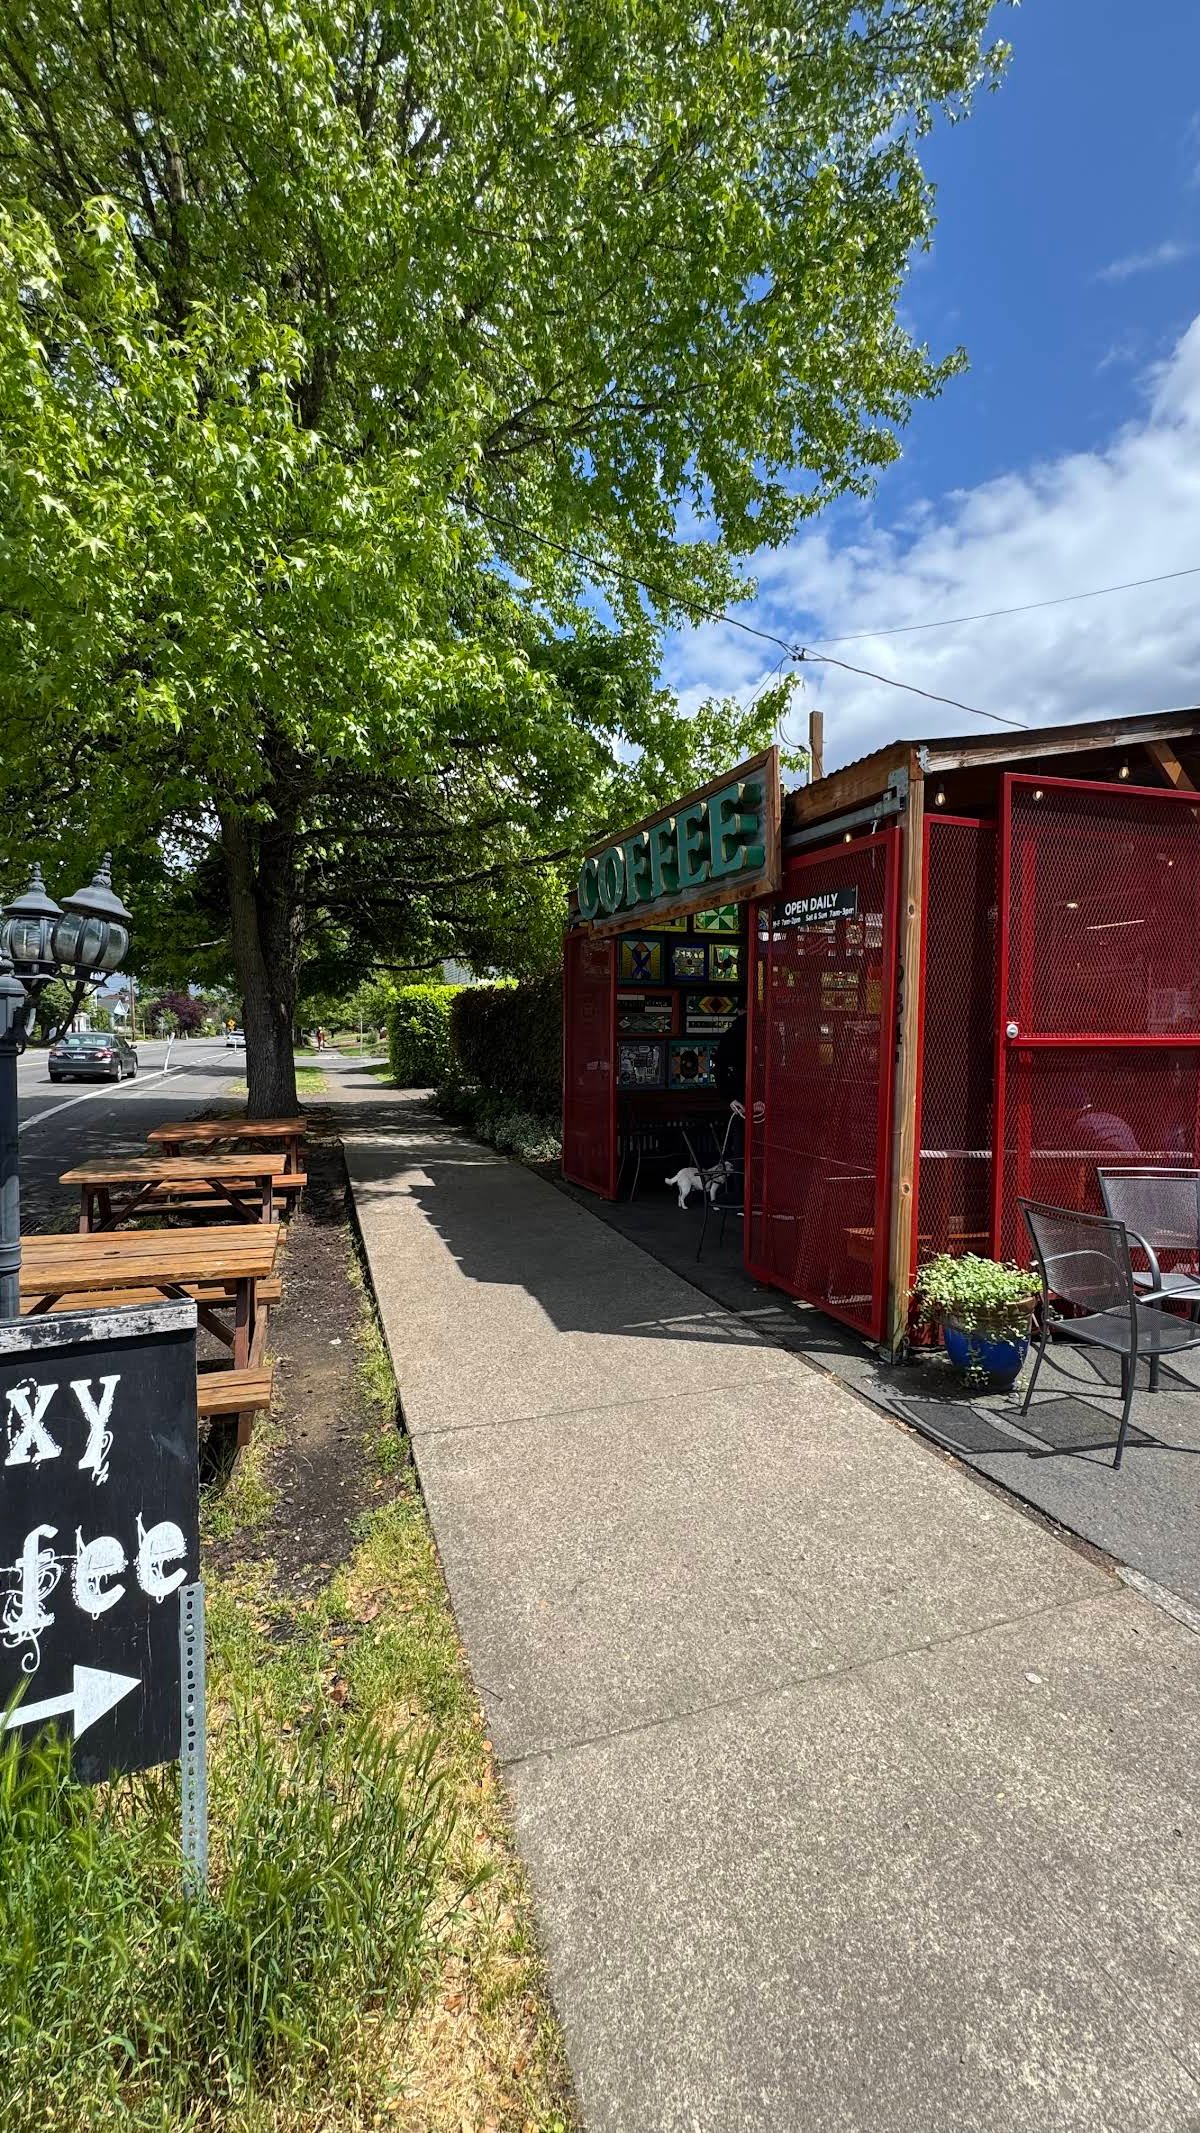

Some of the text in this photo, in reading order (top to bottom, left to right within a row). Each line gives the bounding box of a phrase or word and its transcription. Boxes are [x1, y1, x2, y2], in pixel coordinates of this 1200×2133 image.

[578, 783, 765, 919] COFFEE
[785, 893, 838, 916] OPEN DAILY
[805, 913, 814, 922] Sat
[818, 911, 828, 920] Sun
[2, 1375, 121, 1486] XY
[0, 1511, 188, 1673] fee
